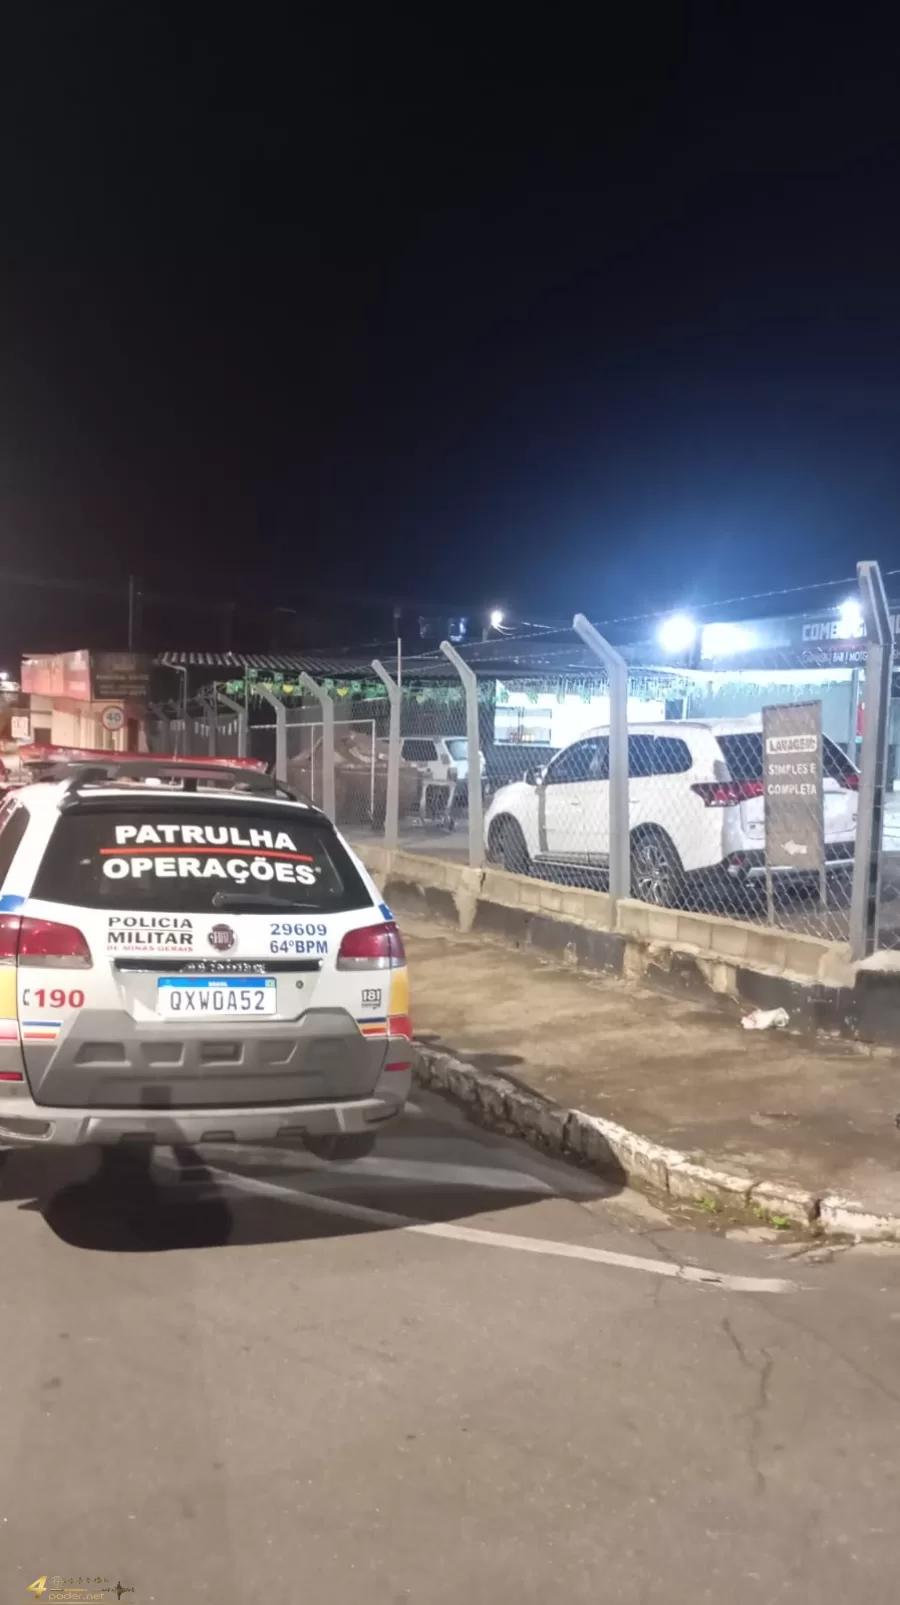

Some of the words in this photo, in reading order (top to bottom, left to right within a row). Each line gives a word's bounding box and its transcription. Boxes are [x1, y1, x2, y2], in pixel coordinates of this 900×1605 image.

[106, 712, 121, 723] 40
[768, 763, 809, 775] SIMPLES
[810, 762, 817, 774] E
[768, 783, 817, 795] COMPLETA
[115, 824, 297, 851] PATRULHA
[102, 857, 316, 885] OPERAÇÕES
[108, 917, 193, 929] POLICIA
[269, 923, 327, 936] 29609
[107, 931, 193, 945] MILITAR
[34, 988, 85, 1008] 190
[363, 989, 381, 1001] 181
